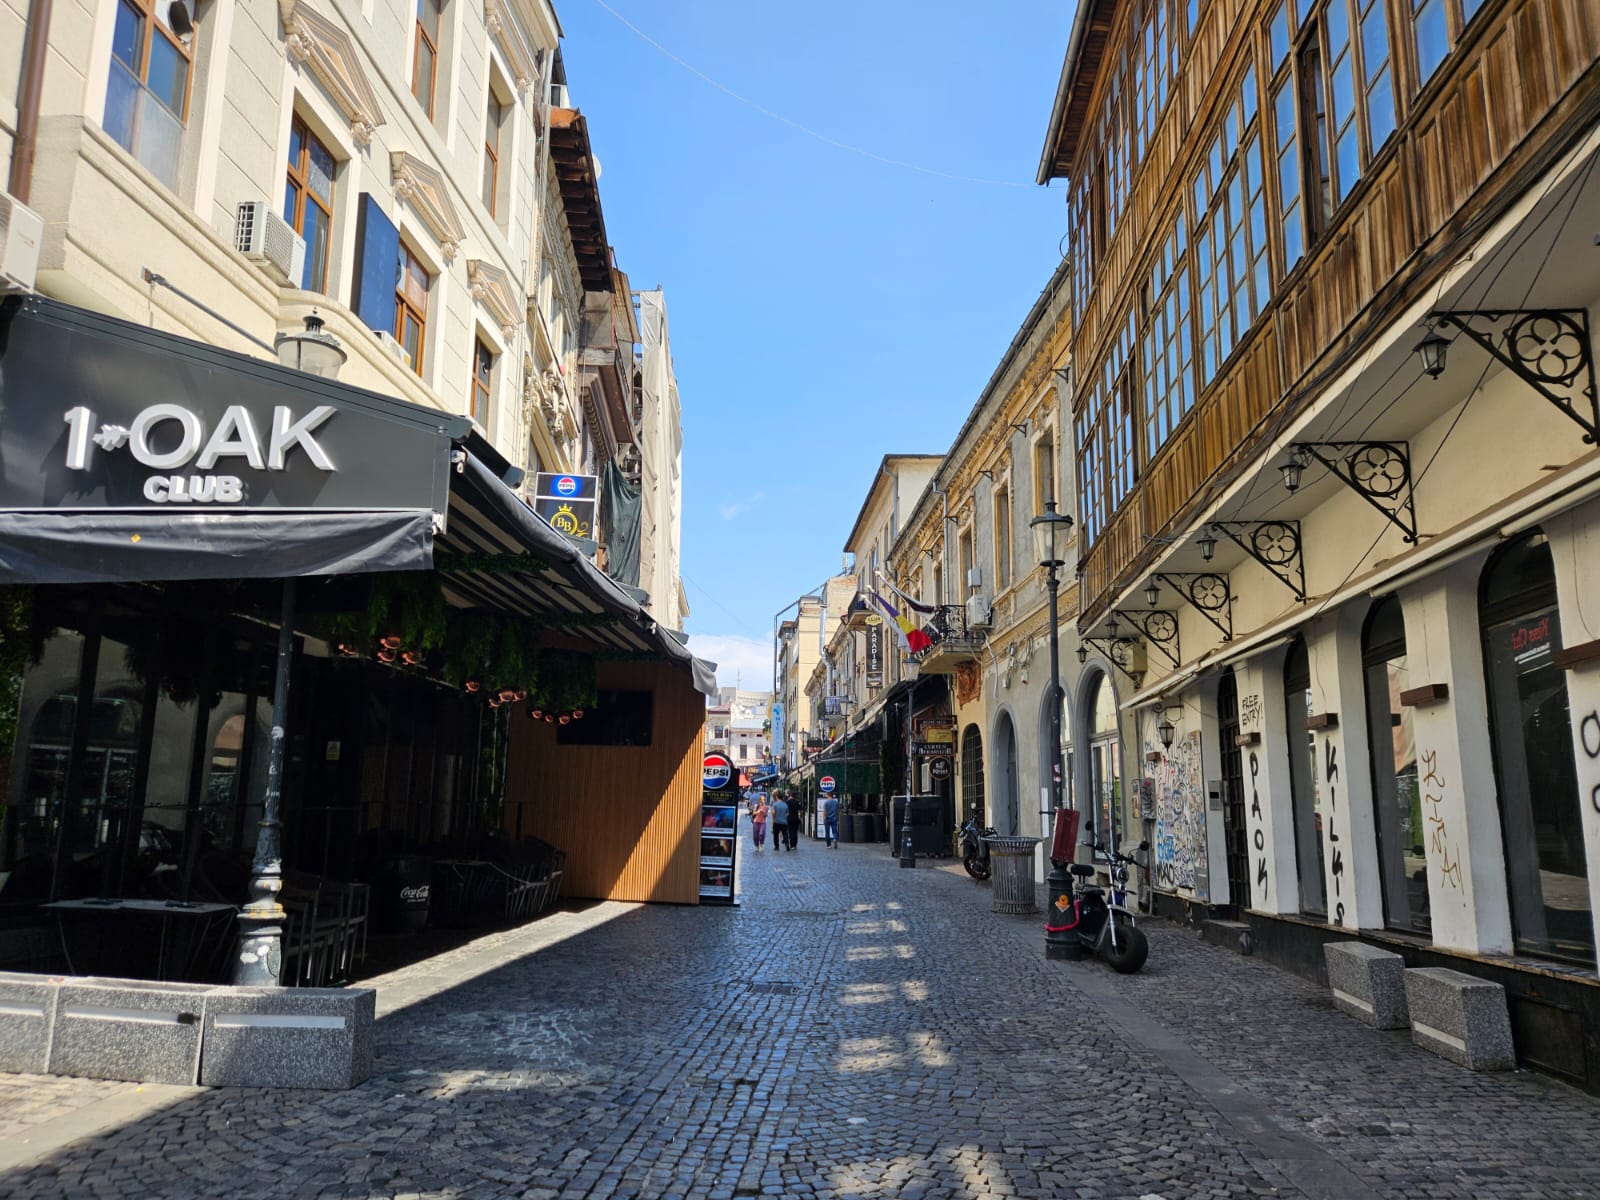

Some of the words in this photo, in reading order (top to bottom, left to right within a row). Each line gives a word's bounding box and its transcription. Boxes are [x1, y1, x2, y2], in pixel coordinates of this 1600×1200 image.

[64, 406, 93, 470] 1
[130, 403, 336, 470] OAK
[143, 475, 244, 502] CLUB
[1242, 694, 1259, 710] FREE
[1250, 752, 1268, 901] PAOK
[1326, 737, 1345, 926] KILKIS
